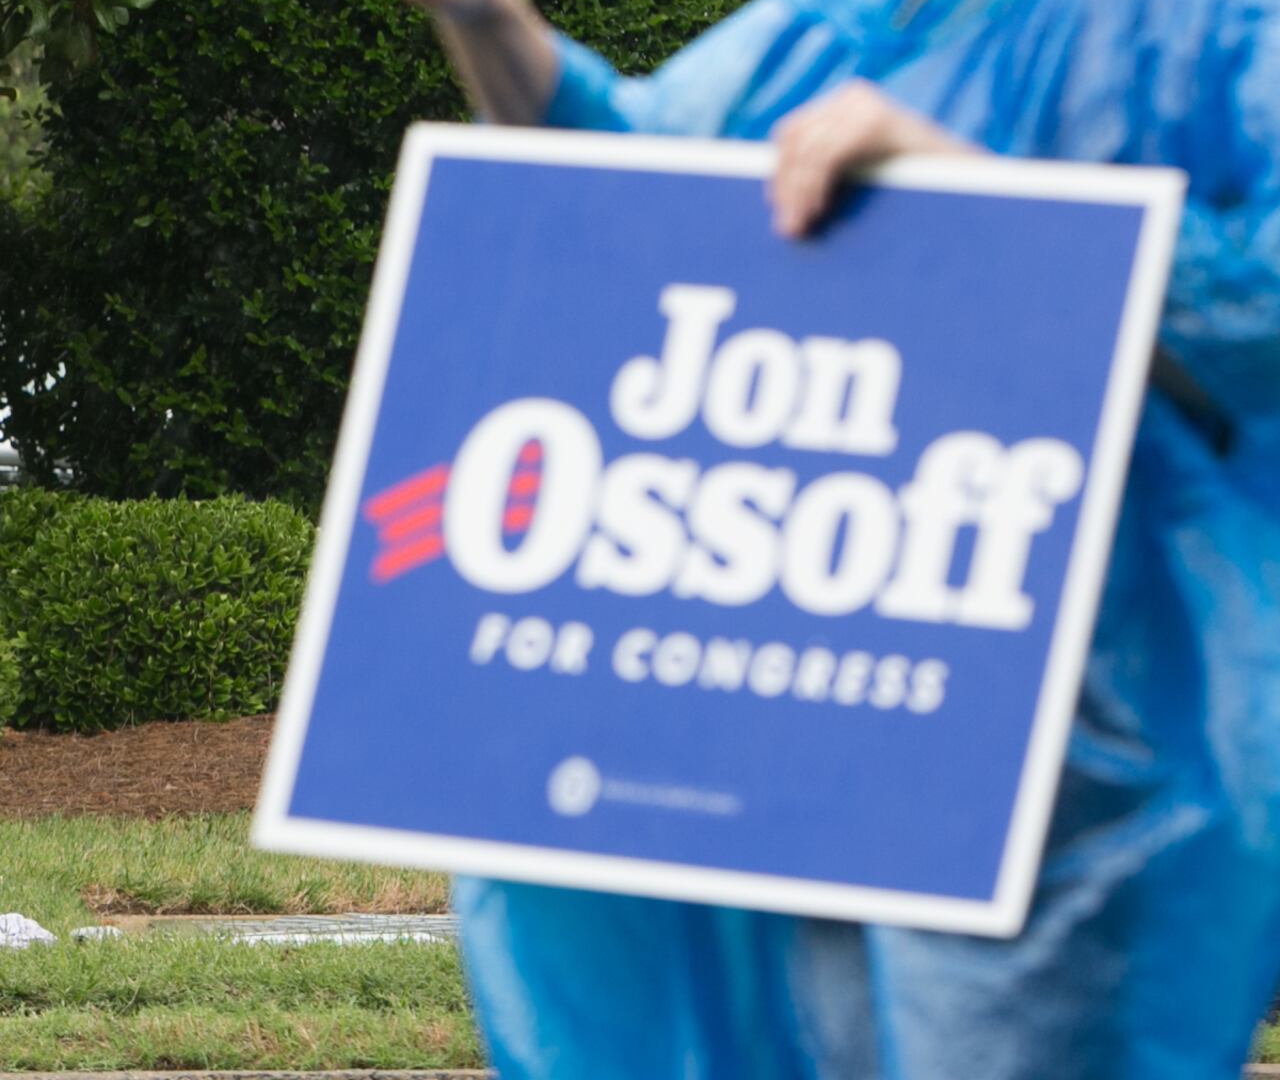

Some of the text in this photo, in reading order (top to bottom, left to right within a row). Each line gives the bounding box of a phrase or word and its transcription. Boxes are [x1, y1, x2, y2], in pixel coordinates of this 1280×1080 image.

[610, 283, 902, 456] Jon
[442, 397, 1084, 631] Ossoff
[470, 612, 948, 714] FOR CONGRESS
